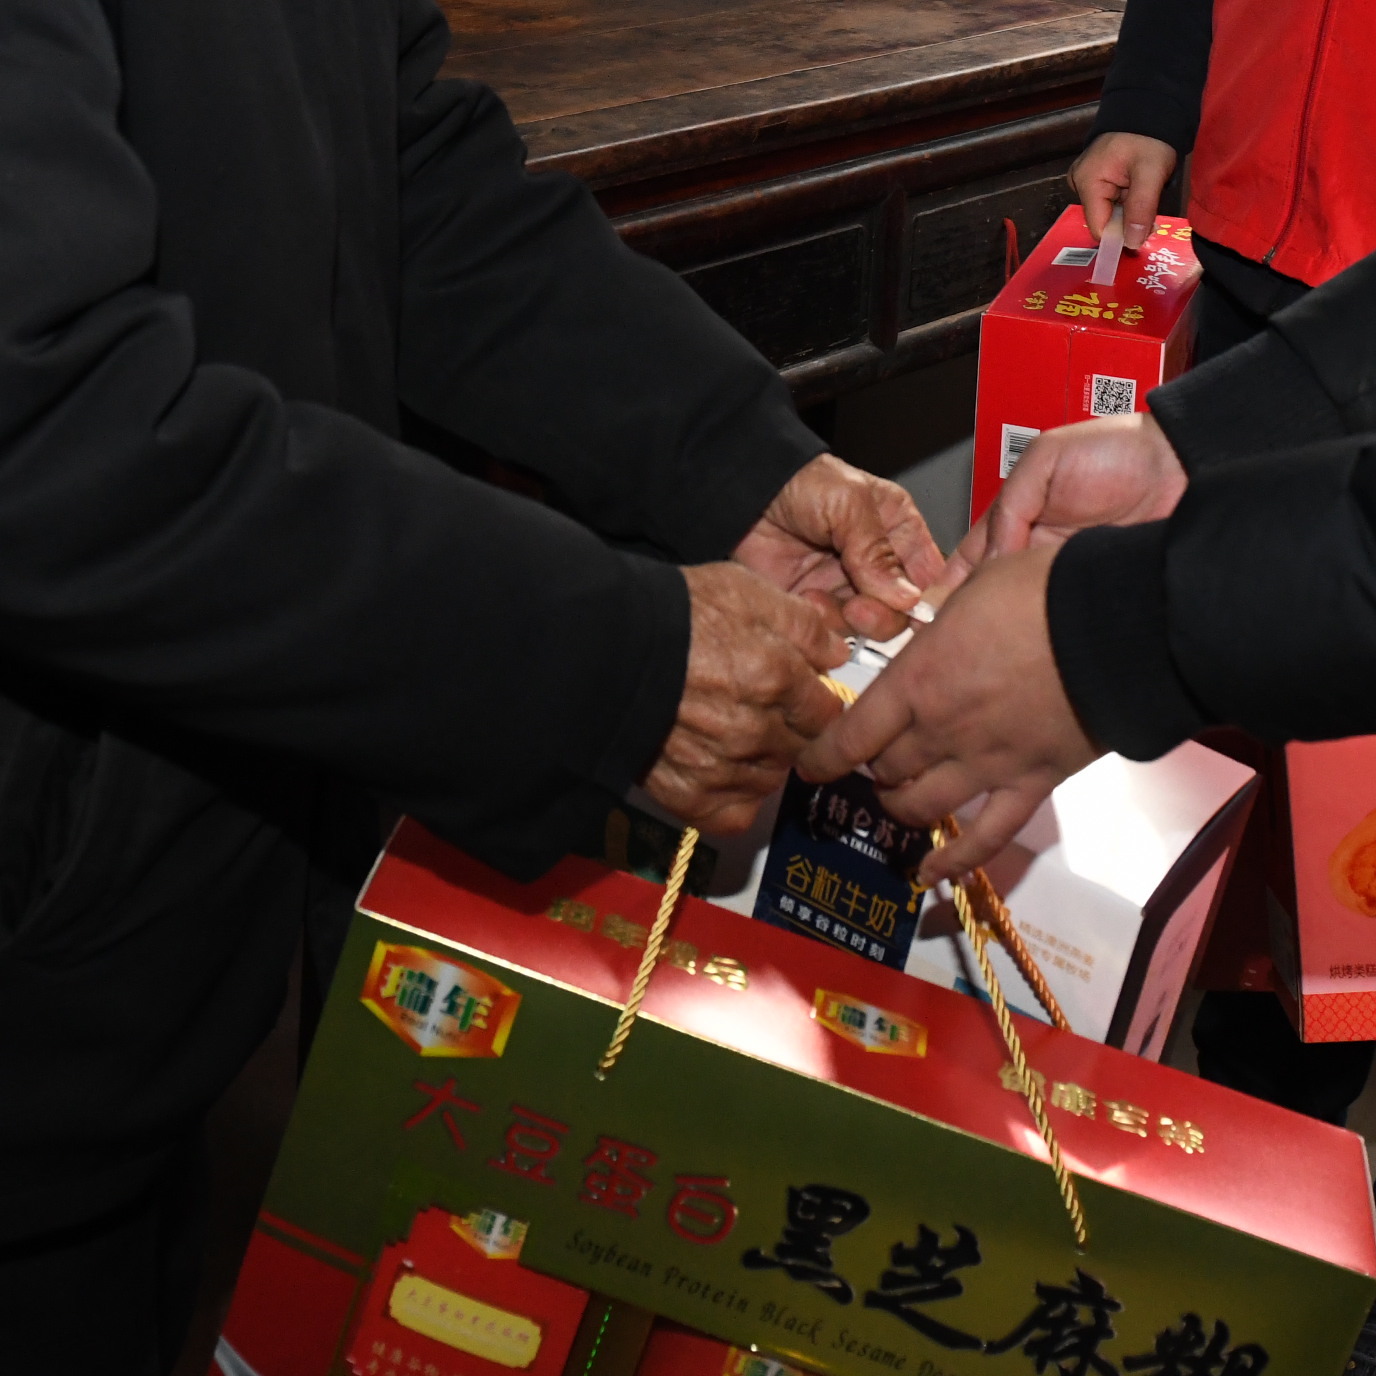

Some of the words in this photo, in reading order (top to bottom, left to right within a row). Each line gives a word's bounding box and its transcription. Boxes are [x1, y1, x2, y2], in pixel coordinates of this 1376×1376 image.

[785, 854, 899, 938] 谷粒牛奶
[380, 963, 493, 1032] 瑞年
[401, 1076, 740, 1246] 大豆蛋白
[565, 1229, 654, 1278] Soybean
[662, 1264, 750, 1315] Protein
[760, 1297, 823, 1346] Black
[830, 1327, 909, 1371] Sesame
